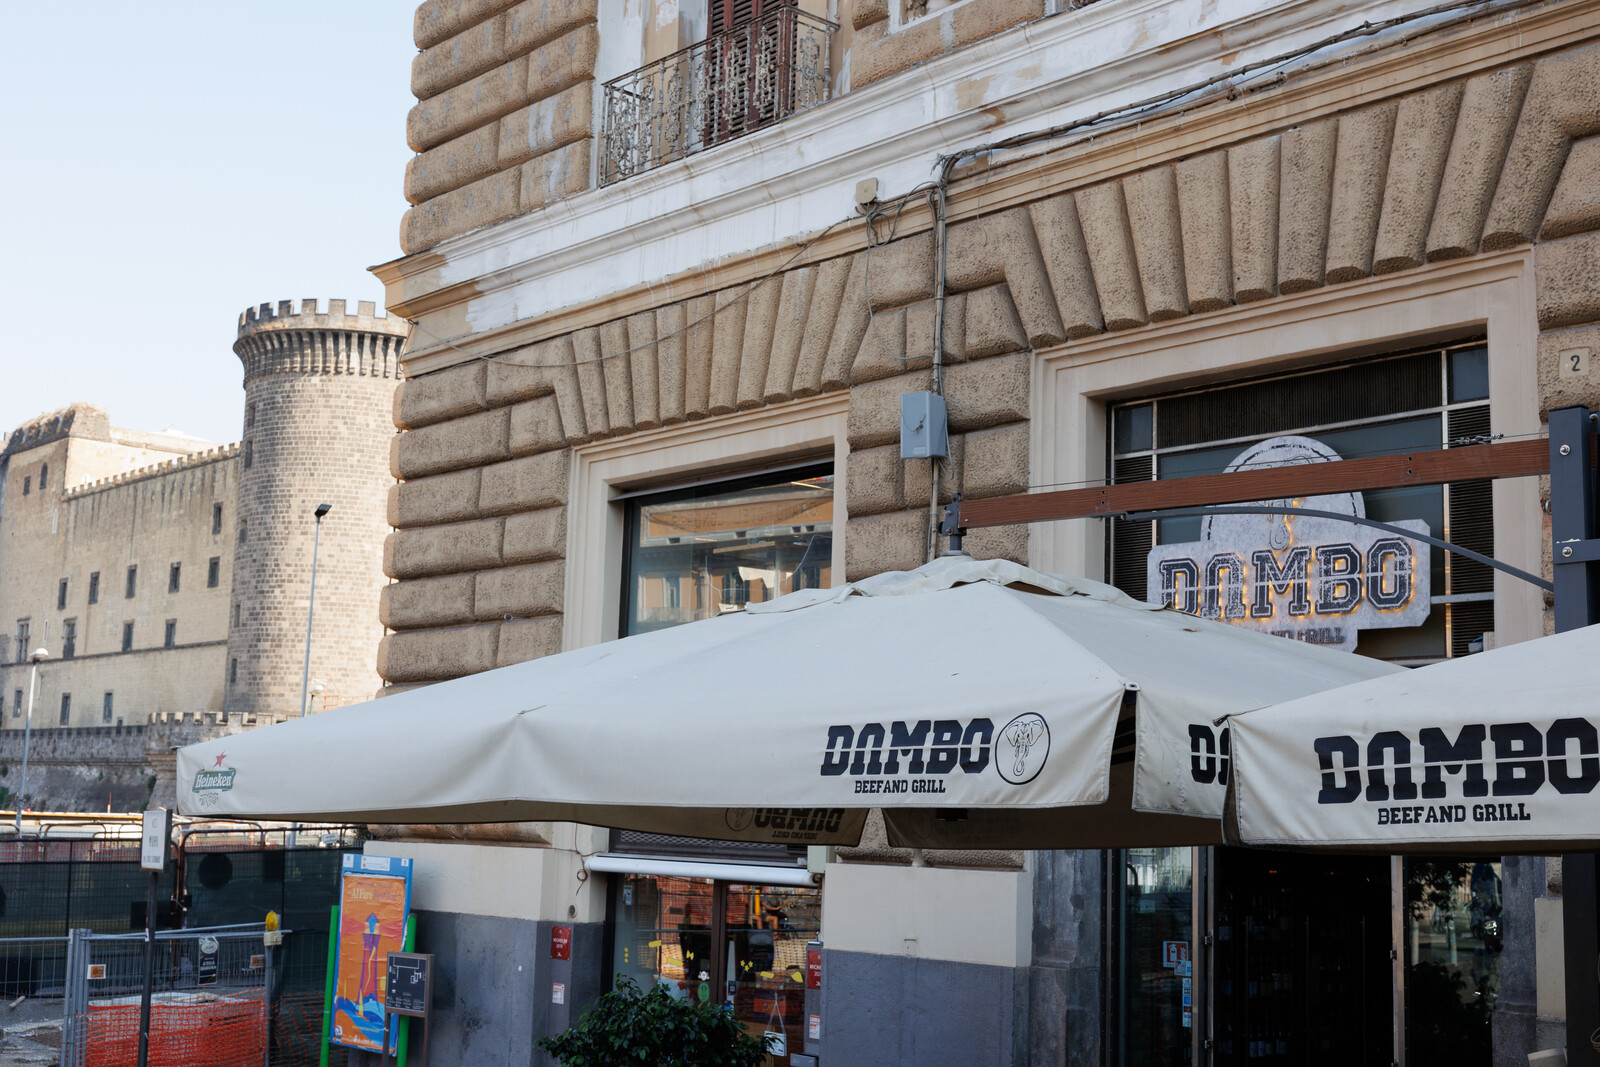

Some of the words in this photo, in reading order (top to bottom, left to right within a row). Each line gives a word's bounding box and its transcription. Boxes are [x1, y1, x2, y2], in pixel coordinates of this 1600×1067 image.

[1570, 354, 1581, 372] 2
[195, 772, 232, 788] Heineken
[911, 779, 946, 793] GRILL
[1472, 797, 1531, 822] GRILL
